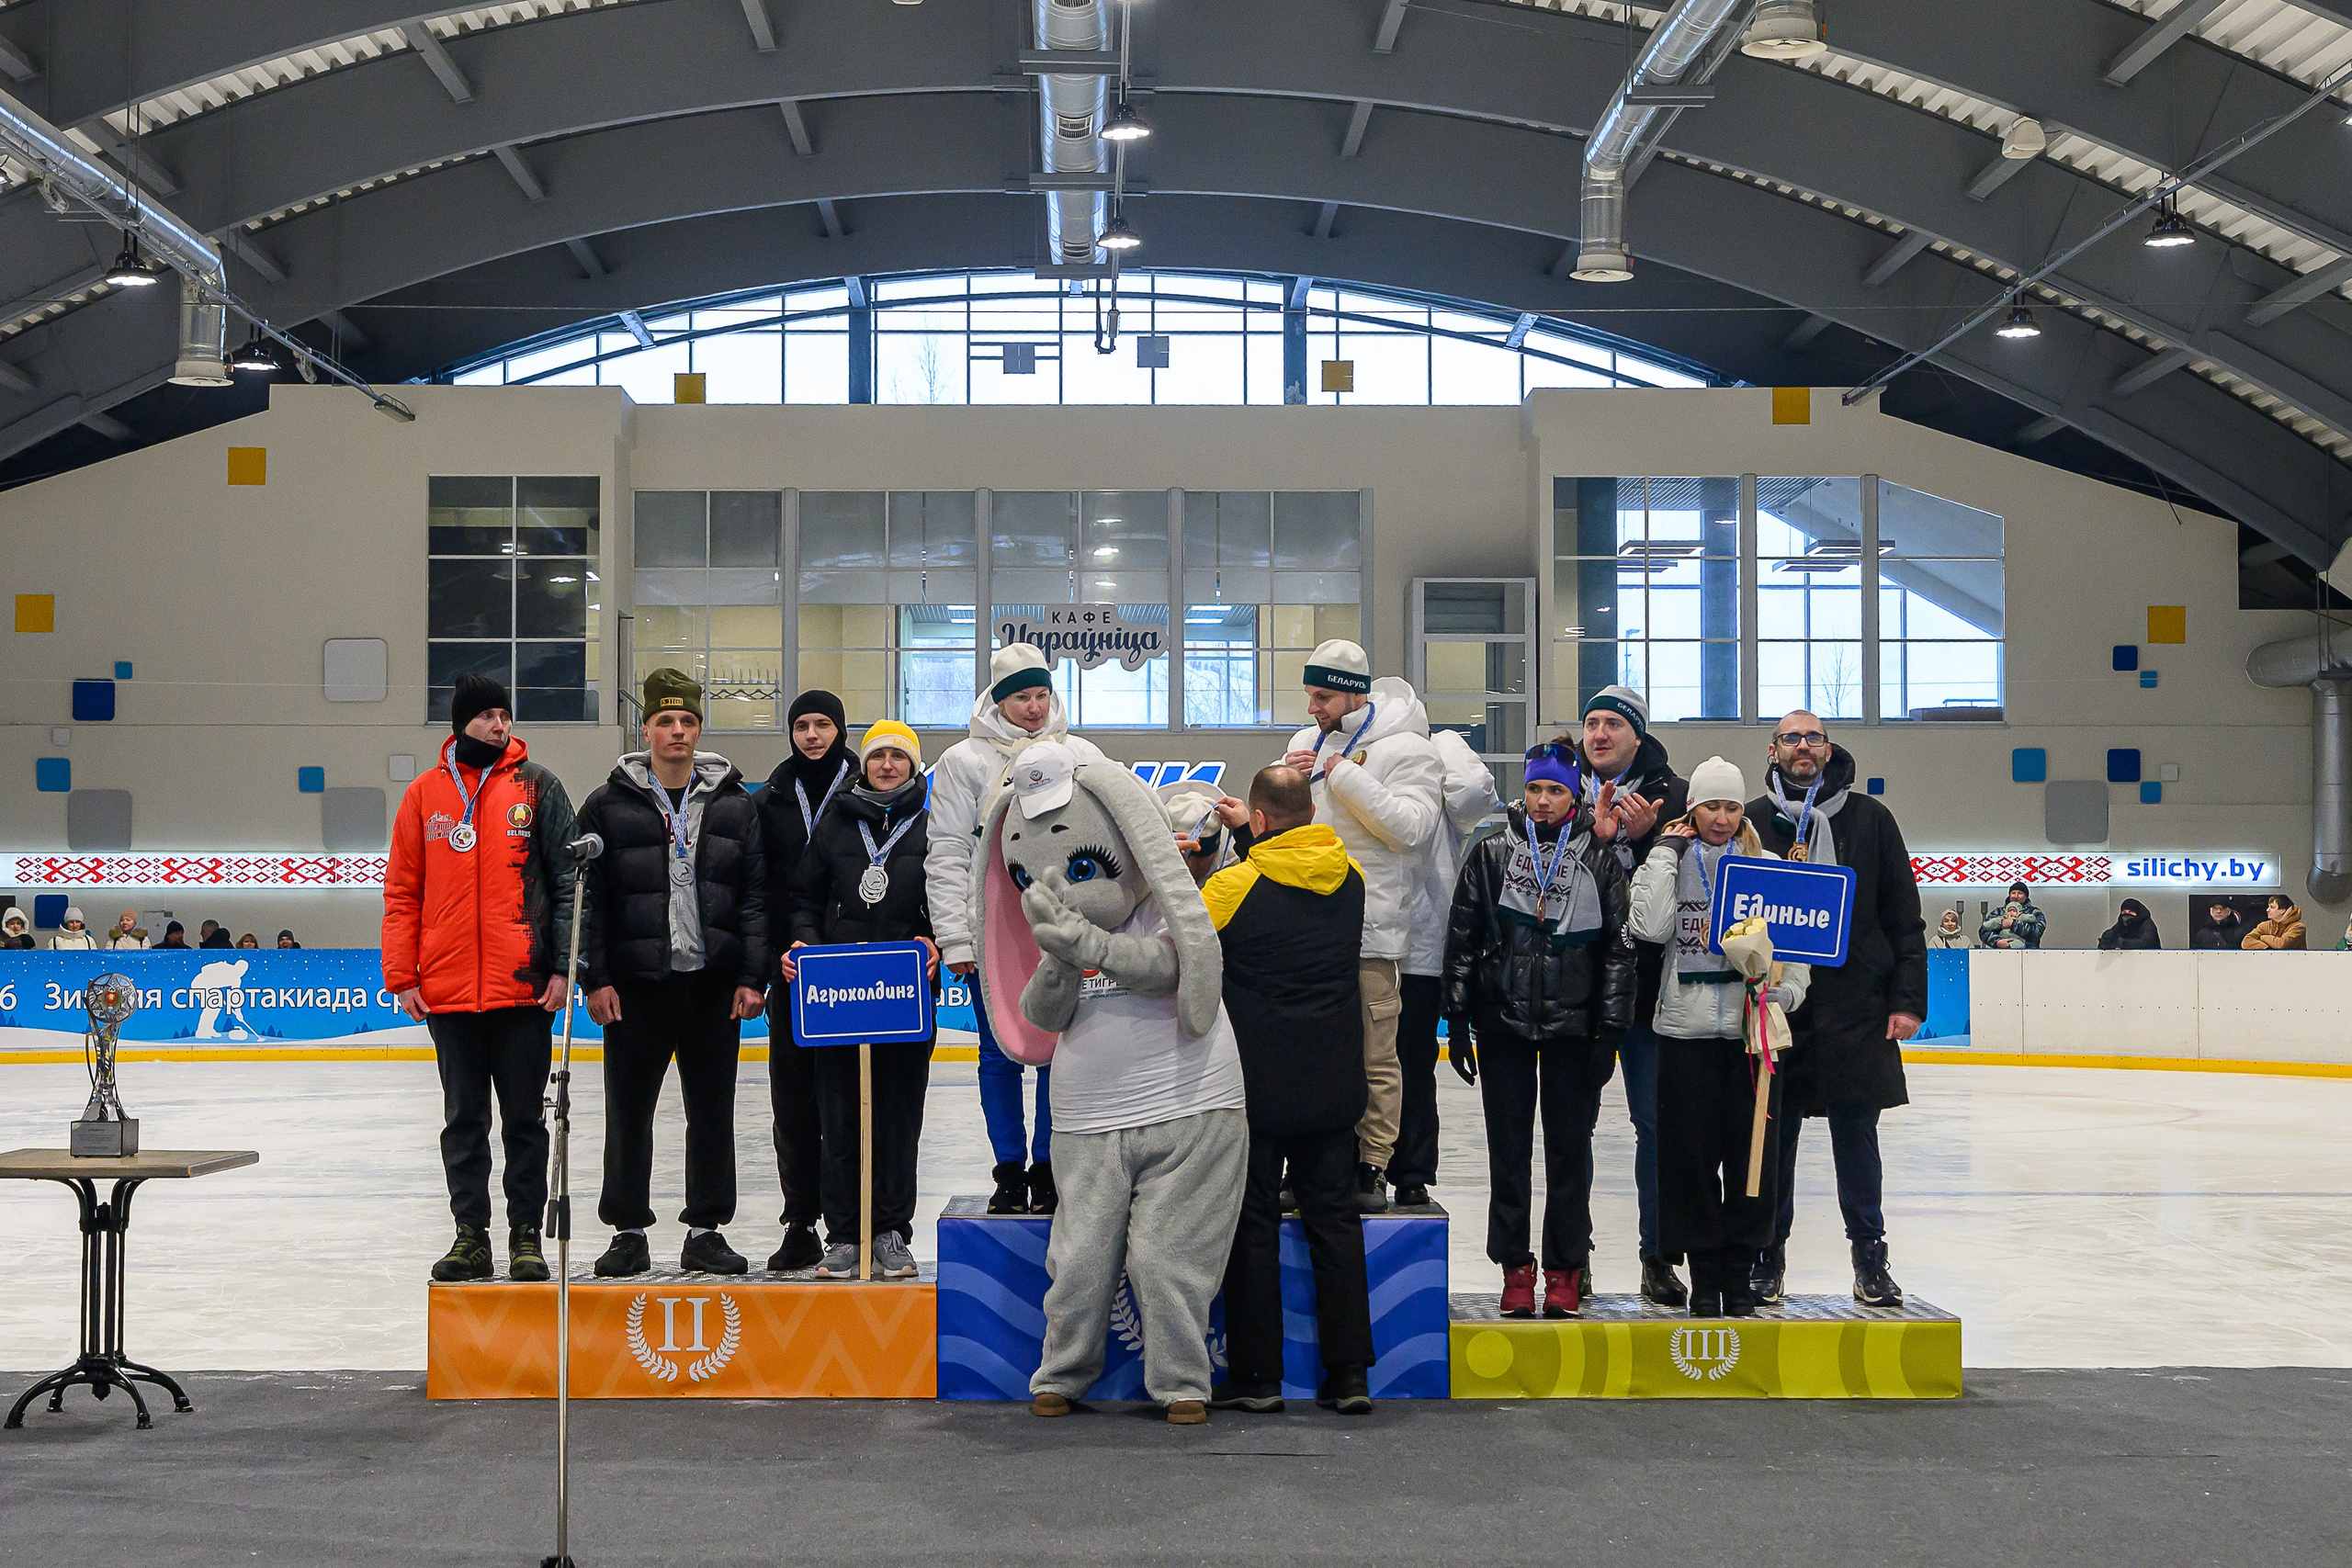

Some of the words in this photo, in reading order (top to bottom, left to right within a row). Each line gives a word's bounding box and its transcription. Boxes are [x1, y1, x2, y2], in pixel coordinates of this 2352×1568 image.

[1051, 611, 1111, 625] КАФЕ
[1327, 674, 1367, 689] БЕЛАРУСЬ
[1515, 853, 1568, 878] ЕДНЕ
[2127, 858, 2265, 881] silichy.by
[1733, 893, 1830, 929] Единые
[806, 980, 915, 1009] Агрохолдинг
[1089, 978, 1120, 989] ТИГР
[44, 983, 162, 1010] Зия
[171, 987, 368, 1015] спартакиада
[656, 1297, 711, 1352] II
[1681, 1329, 1729, 1360] III
